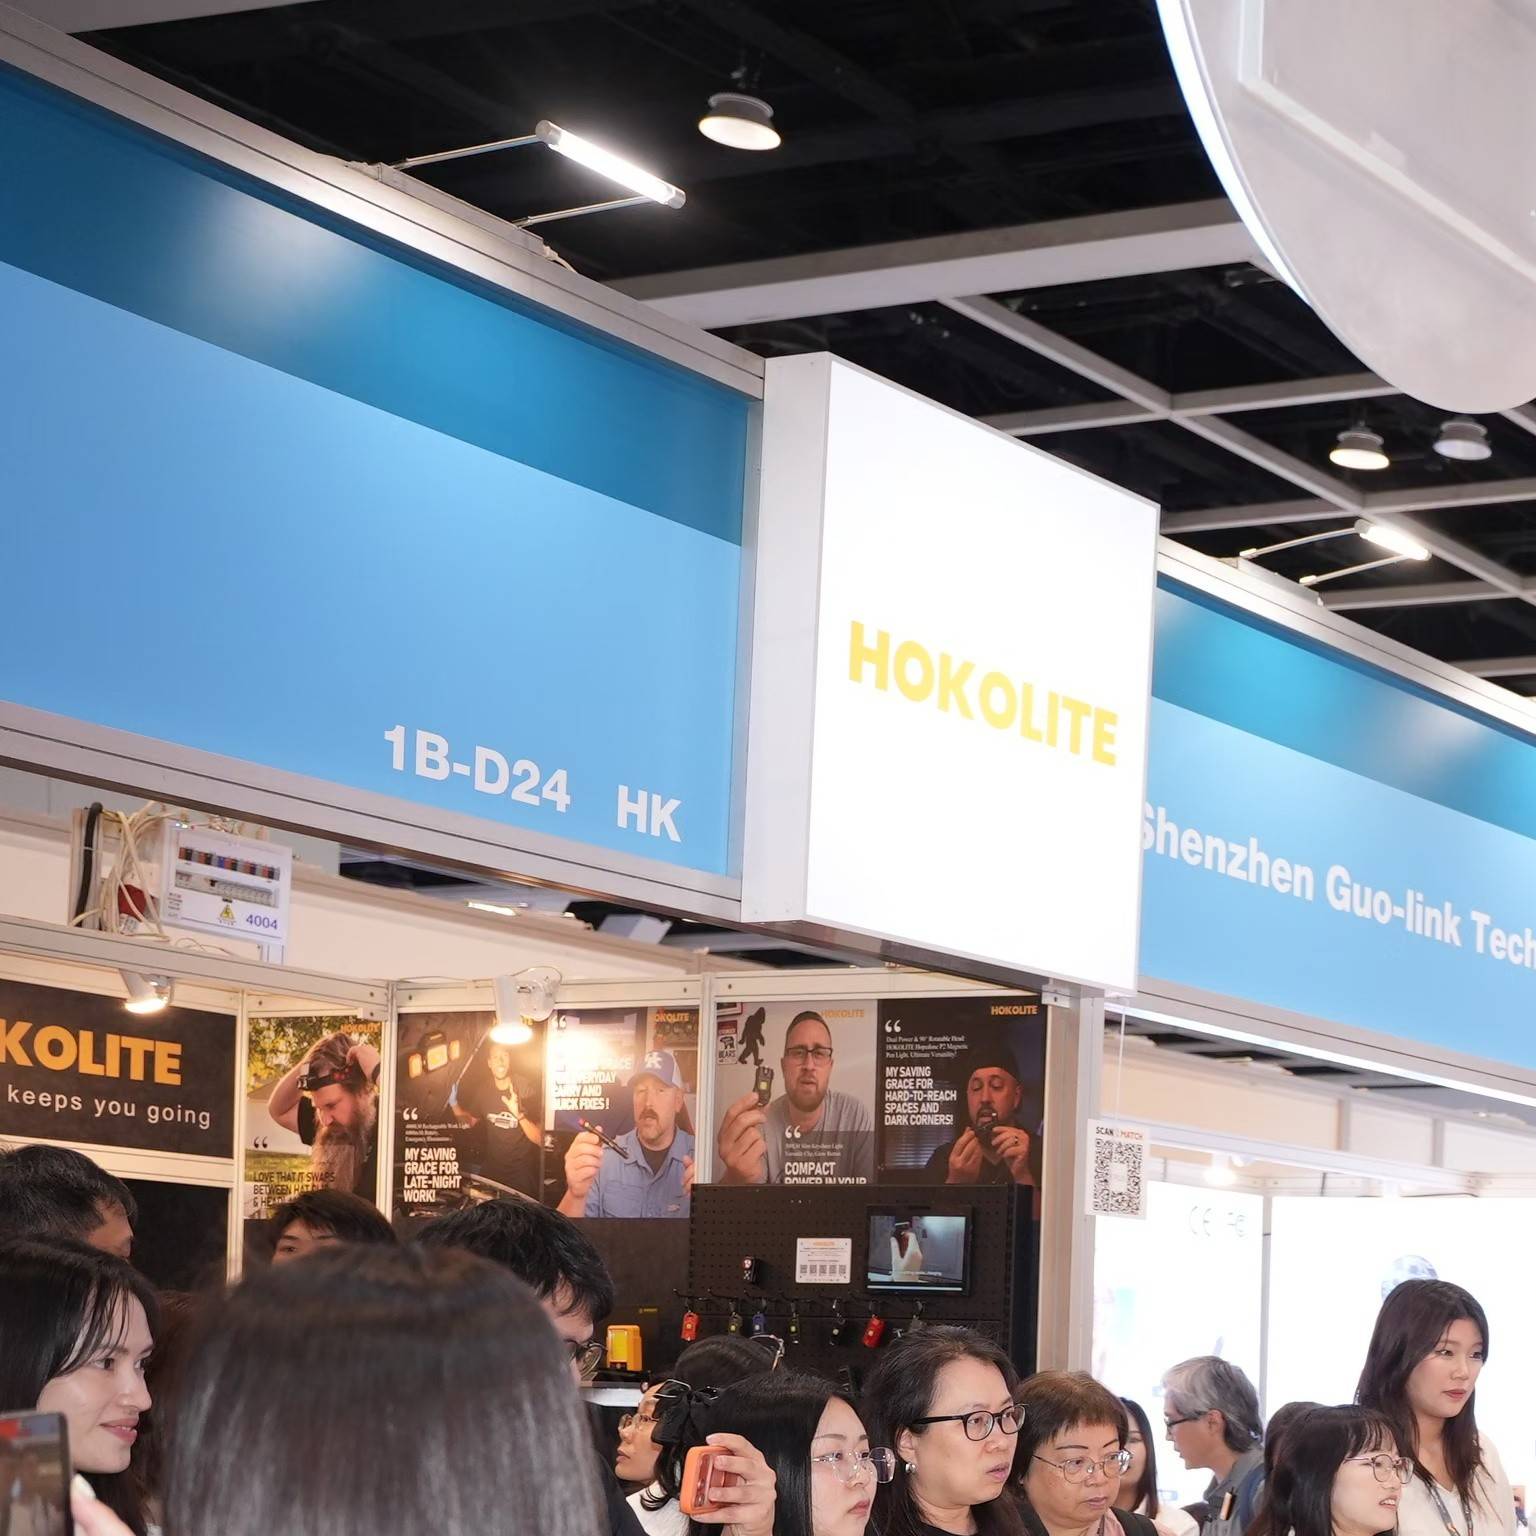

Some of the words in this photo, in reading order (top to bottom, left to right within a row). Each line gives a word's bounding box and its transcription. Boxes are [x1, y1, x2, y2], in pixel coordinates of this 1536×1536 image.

[849, 620, 1118, 766] HOKOLITE
[384, 725, 571, 813] 1B-D24
[616, 785, 682, 843] HK
[1143, 801, 1314, 901] Shenzhen
[1326, 865, 1462, 947] Guo-link
[246, 914, 278, 930] 4004
[821, 1009, 865, 1018] HOKOLITE
[991, 1005, 1038, 1015] HOKOLITE
[0, 1019, 182, 1086] KOLITE
[885, 1067, 898, 1077] MY
[899, 1066, 931, 1077] SAVING
[885, 1079, 914, 1089] GRACE
[916, 1078, 933, 1089] FOR
[582, 1084, 602, 1097] AND
[885, 1090, 957, 1101] HARD-TO-REACH
[7, 1084, 82, 1113] keeps
[94, 1098, 136, 1118] you
[147, 1105, 211, 1130] going
[579, 1097, 605, 1110] FIXES
[884, 1103, 918, 1113] SPACES
[920, 1102, 939, 1113] AND
[884, 1115, 908, 1126] DARK
[910, 1115, 954, 1126] CORNERS!
[1096, 1126, 1114, 1136] SCAN
[1120, 1131, 1143, 1140] MATCH
[404, 1148, 419, 1161] MY
[420, 1147, 457, 1161] SAVING
[404, 1162, 438, 1175] GRACE
[439, 1161, 459, 1174] FOR
[784, 1162, 836, 1176] COMPACT
[253, 1172, 274, 1183] LOVE
[276, 1172, 296, 1183] THAT
[305, 1172, 336, 1182] SWAPS
[404, 1175, 463, 1189] LATE-NIGHT
[253, 1184, 292, 1195] BETWEEN
[403, 1189, 436, 1202] WORK!
